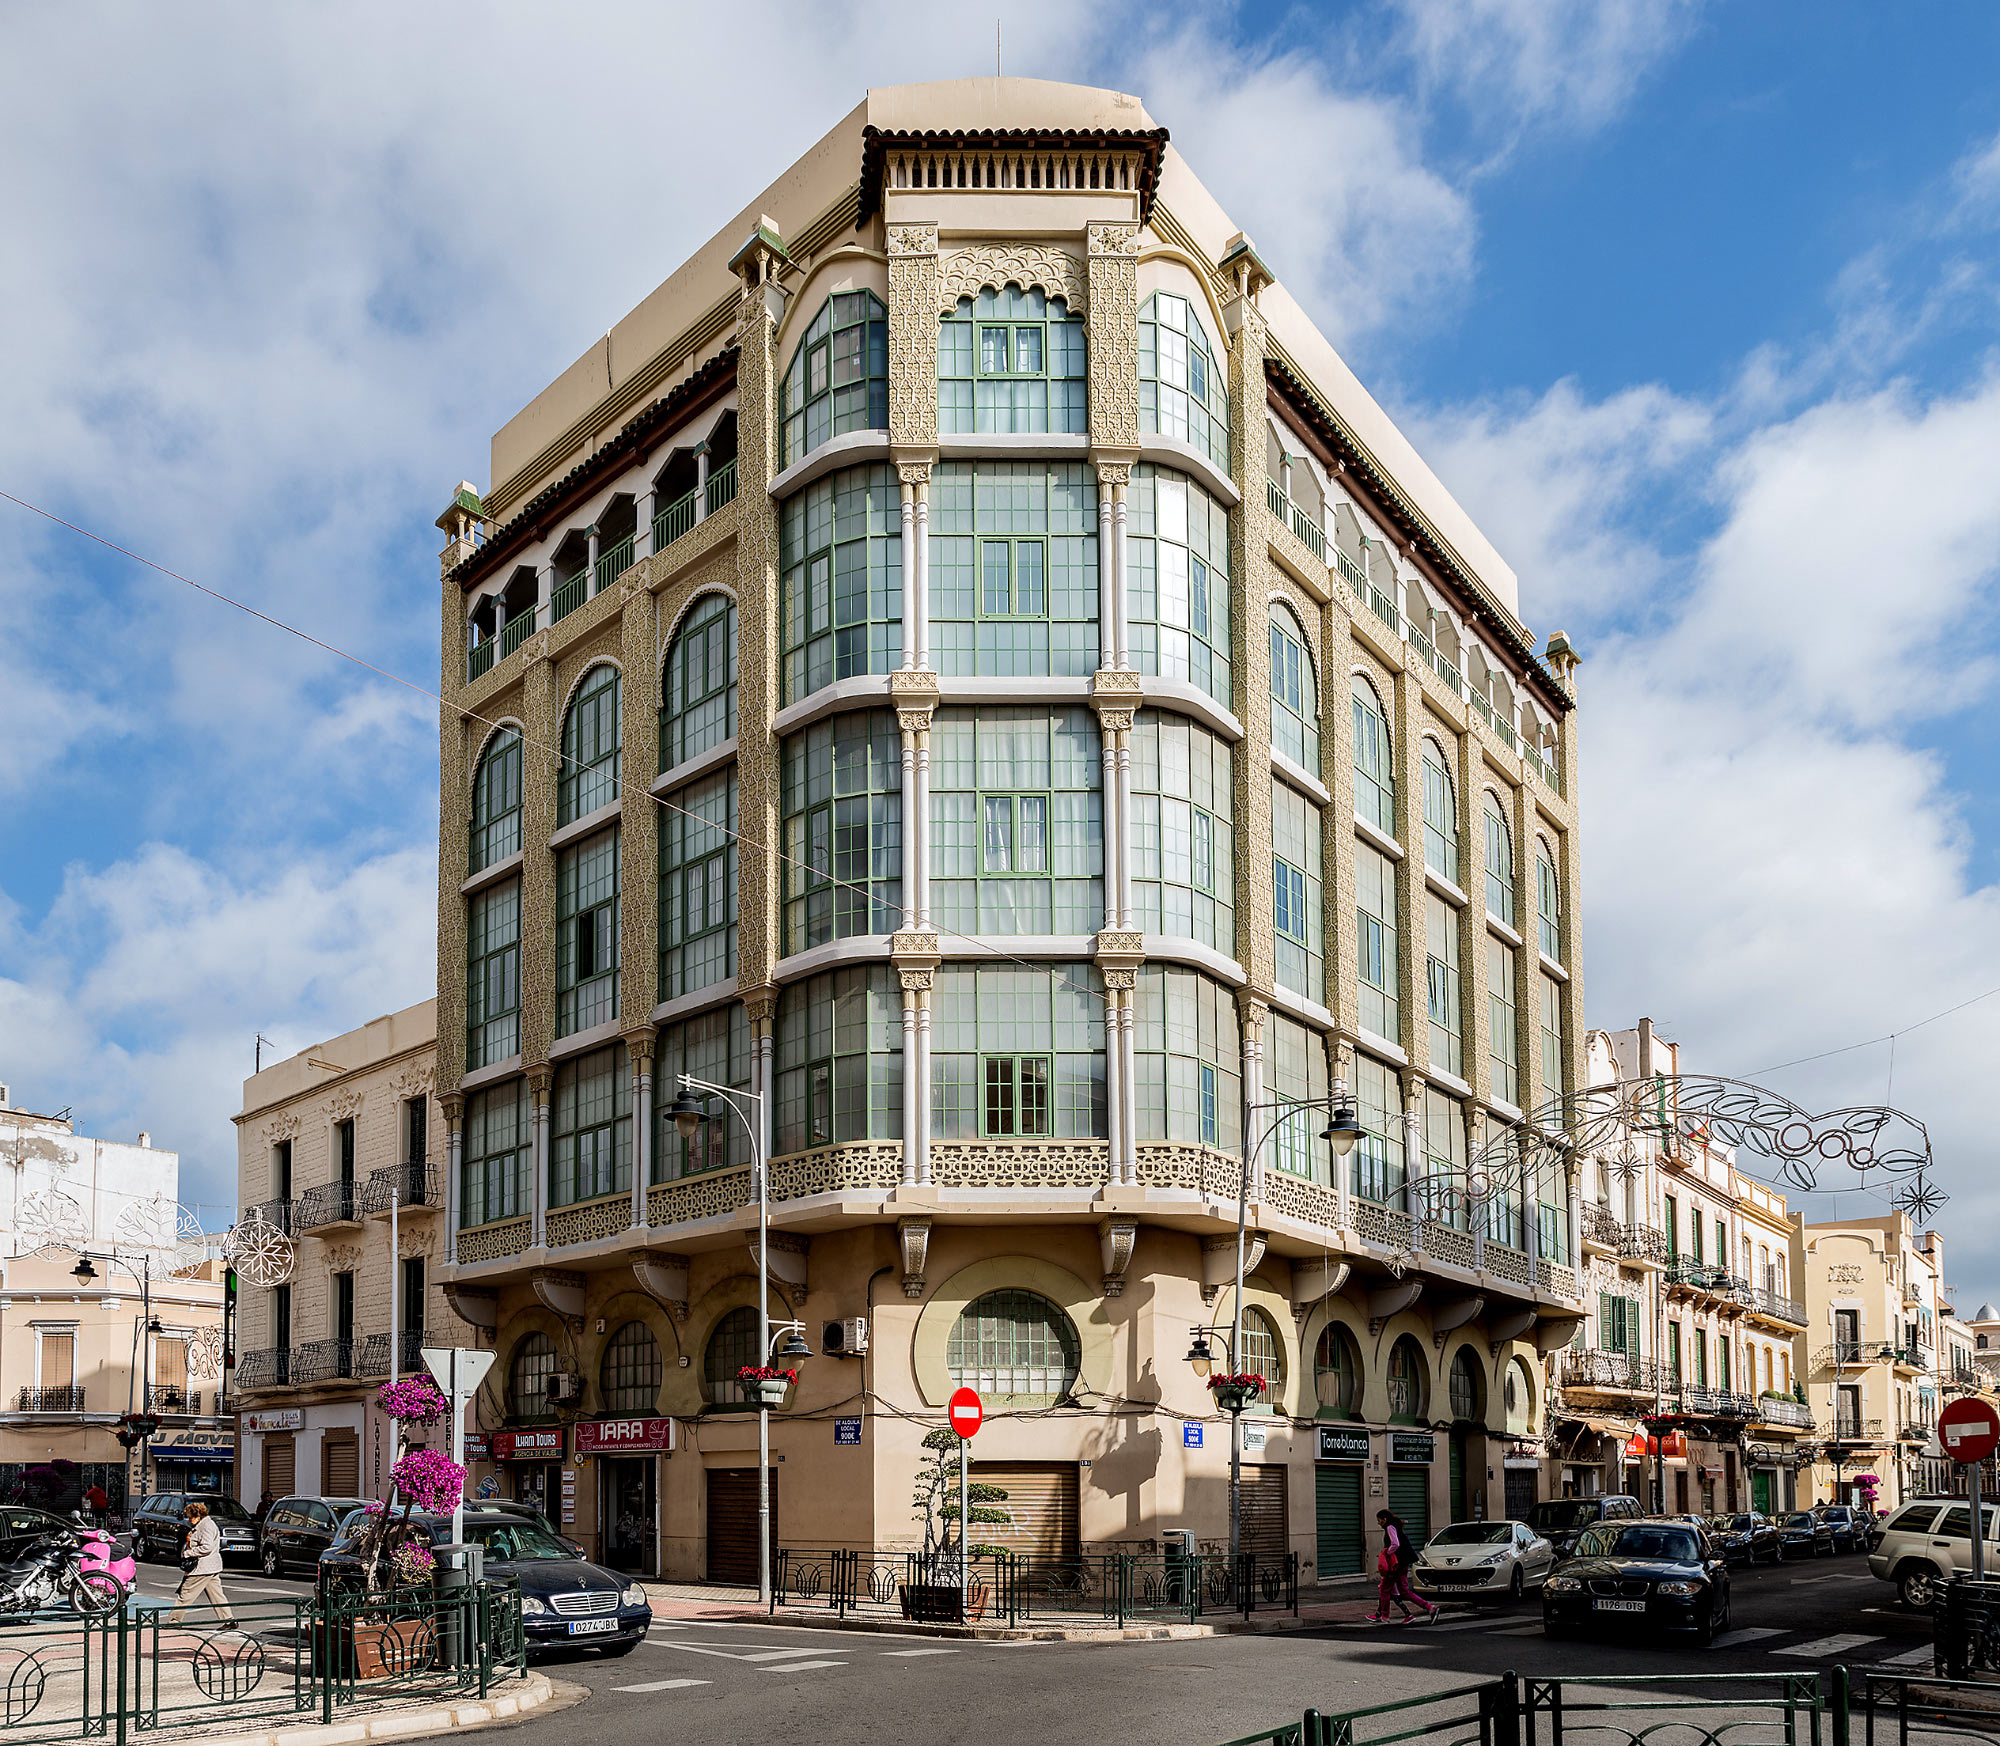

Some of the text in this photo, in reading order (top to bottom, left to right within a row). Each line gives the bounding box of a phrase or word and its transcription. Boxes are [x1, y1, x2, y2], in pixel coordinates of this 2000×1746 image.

[600, 1421, 643, 1441] IARA
[536, 1433, 557, 1447] TOURS
[1322, 1433, 1368, 1450] Torreblanca
[576, 1620, 616, 1632] 0274 JBK
